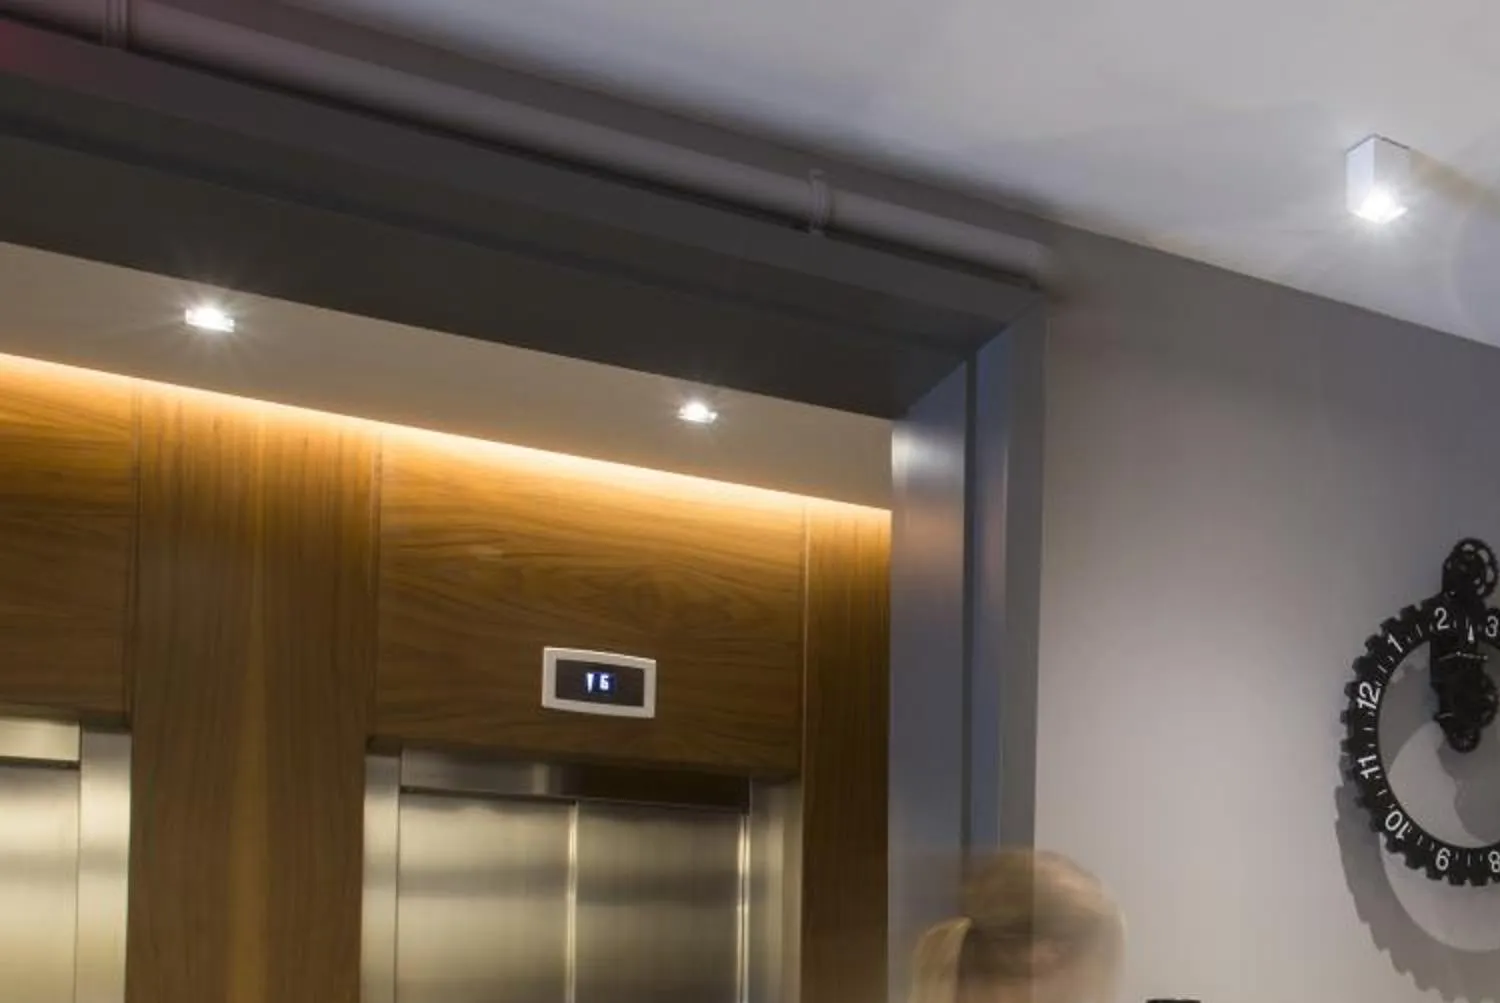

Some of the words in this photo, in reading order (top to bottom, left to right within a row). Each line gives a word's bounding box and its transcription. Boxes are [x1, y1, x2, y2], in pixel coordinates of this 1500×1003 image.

[1434, 607, 1450, 630] 2
[1485, 615, 1499, 637] 3
[1387, 633, 1404, 653] 1
[1356, 682, 1381, 710] 12
[1357, 754, 1379, 779] 11
[1385, 810, 1411, 840] 10
[1434, 847, 1451, 871] 9
